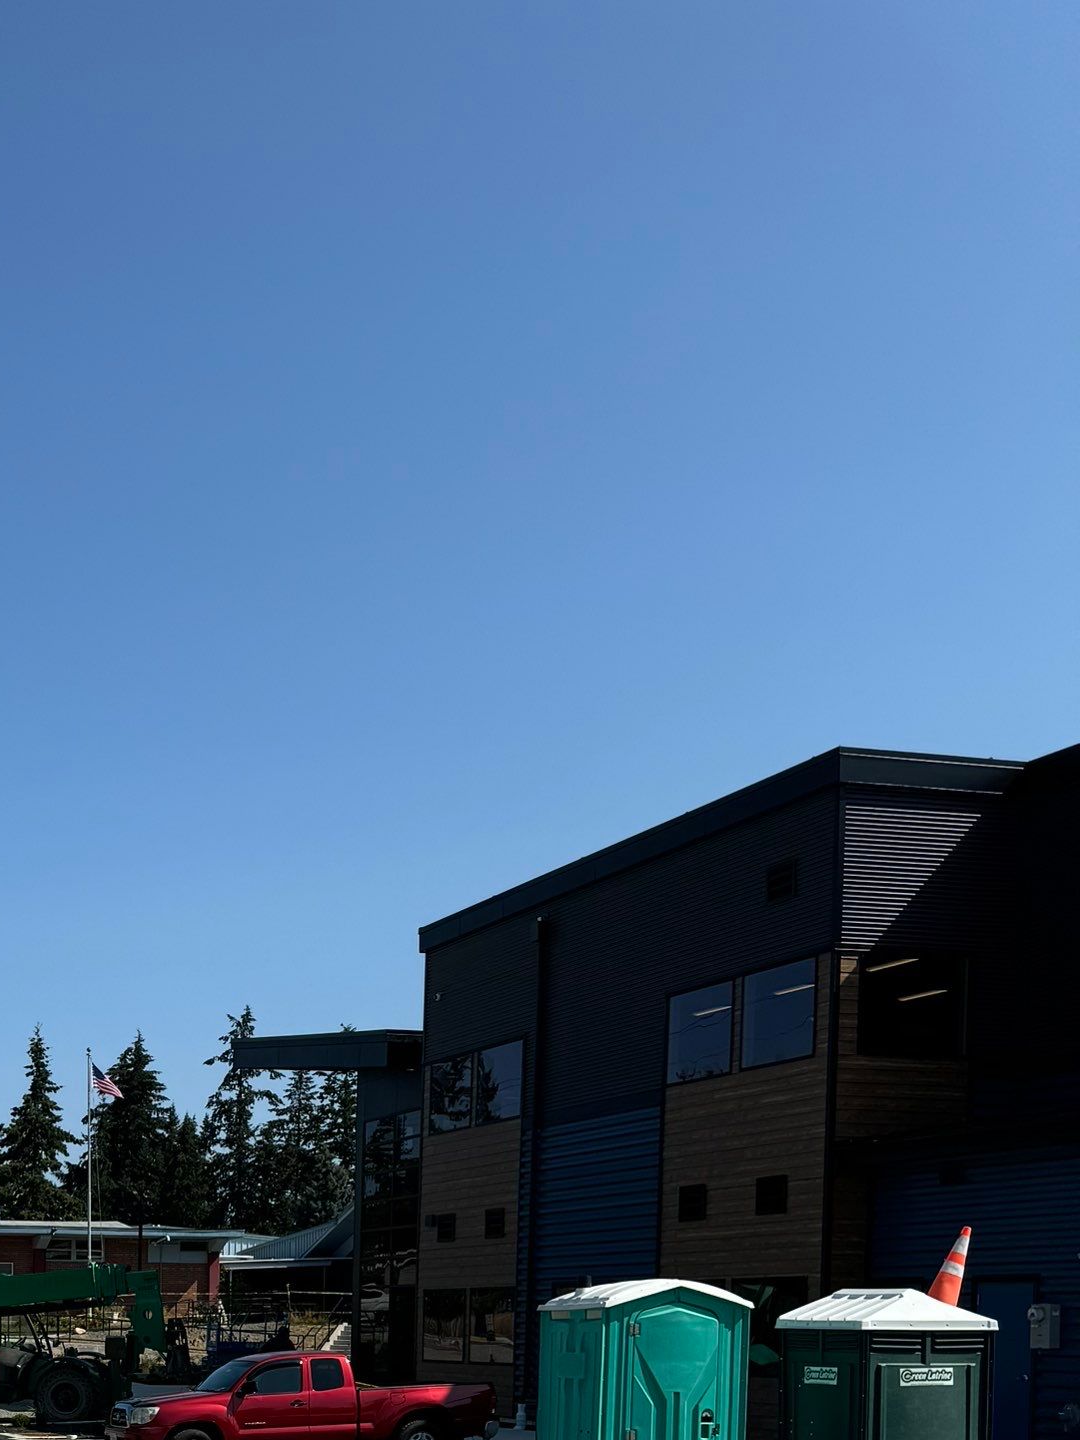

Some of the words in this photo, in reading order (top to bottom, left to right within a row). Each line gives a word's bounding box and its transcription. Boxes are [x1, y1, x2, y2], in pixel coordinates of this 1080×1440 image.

[805, 1368, 820, 1381] Green
[901, 1369, 927, 1383] Green
[926, 1369, 953, 1382] Latrine
